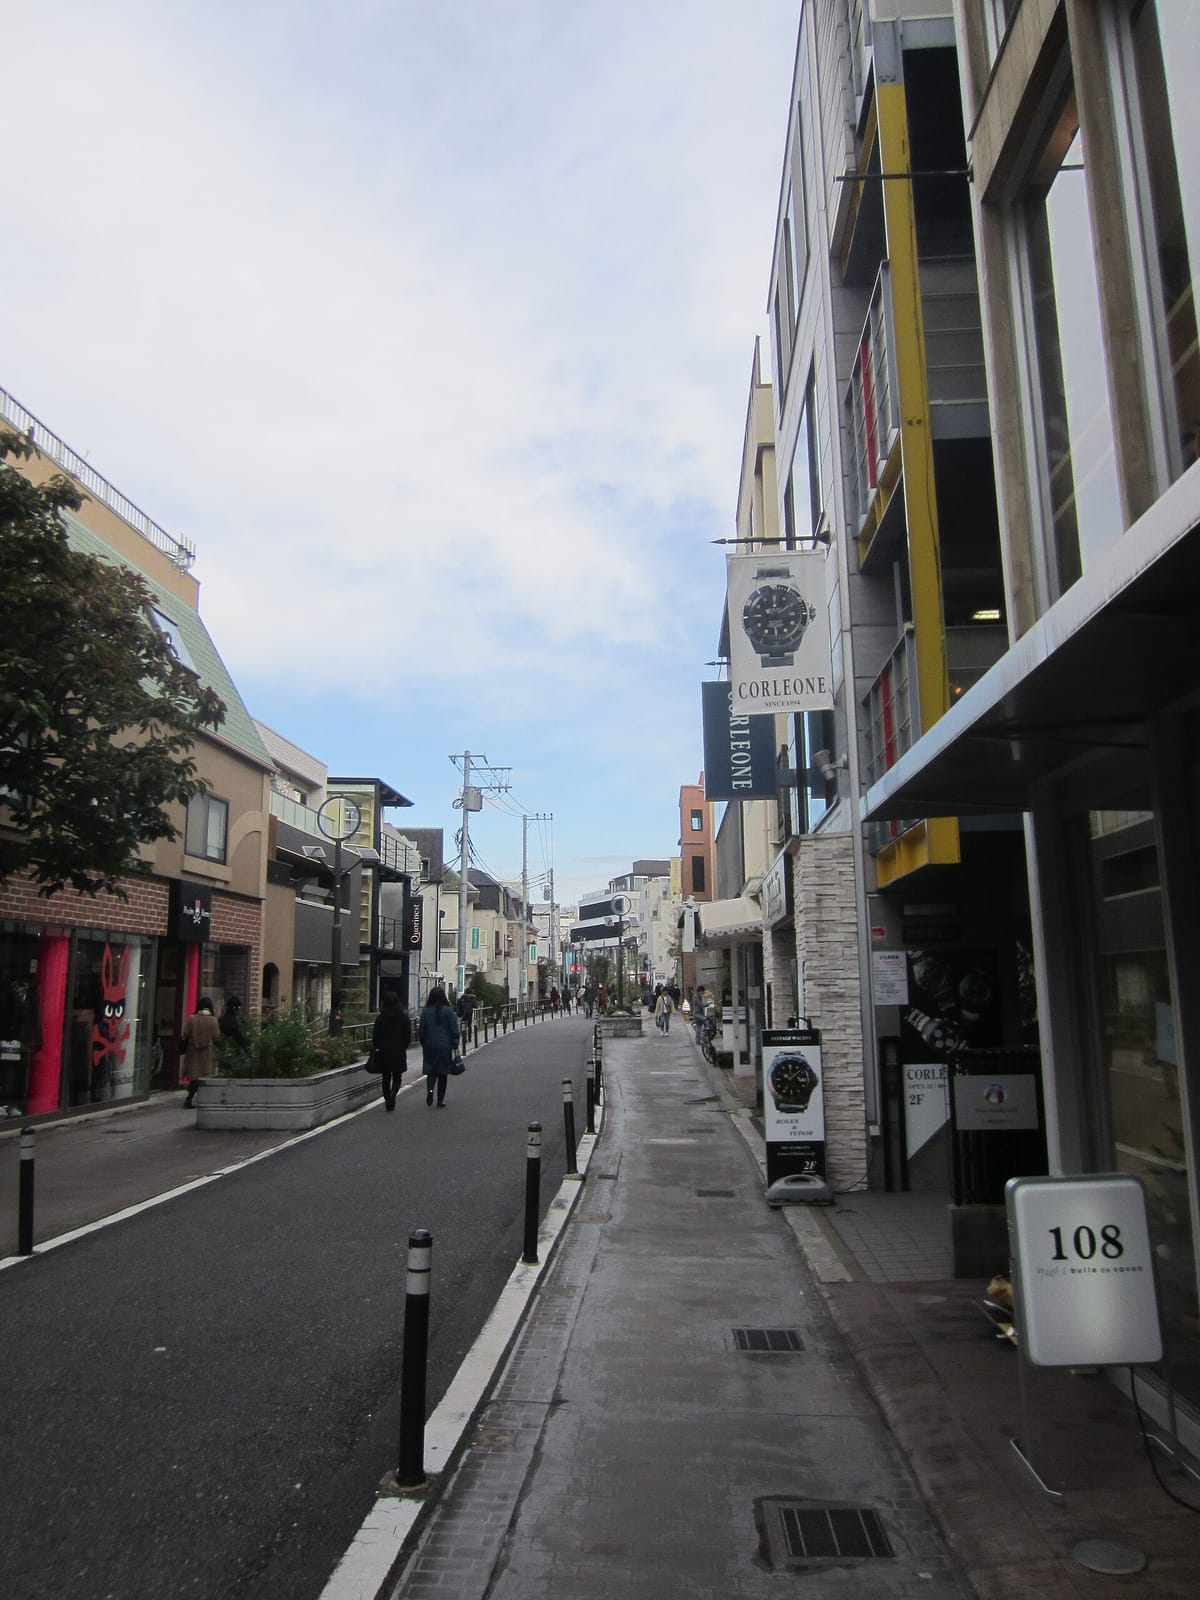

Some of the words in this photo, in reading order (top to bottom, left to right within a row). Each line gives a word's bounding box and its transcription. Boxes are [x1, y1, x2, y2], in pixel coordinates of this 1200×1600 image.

[738, 677, 826, 699] CORLEONE
[909, 1094, 925, 1105] 2F
[803, 1160, 817, 1170] 2F
[1048, 1224, 1124, 1260] 108
